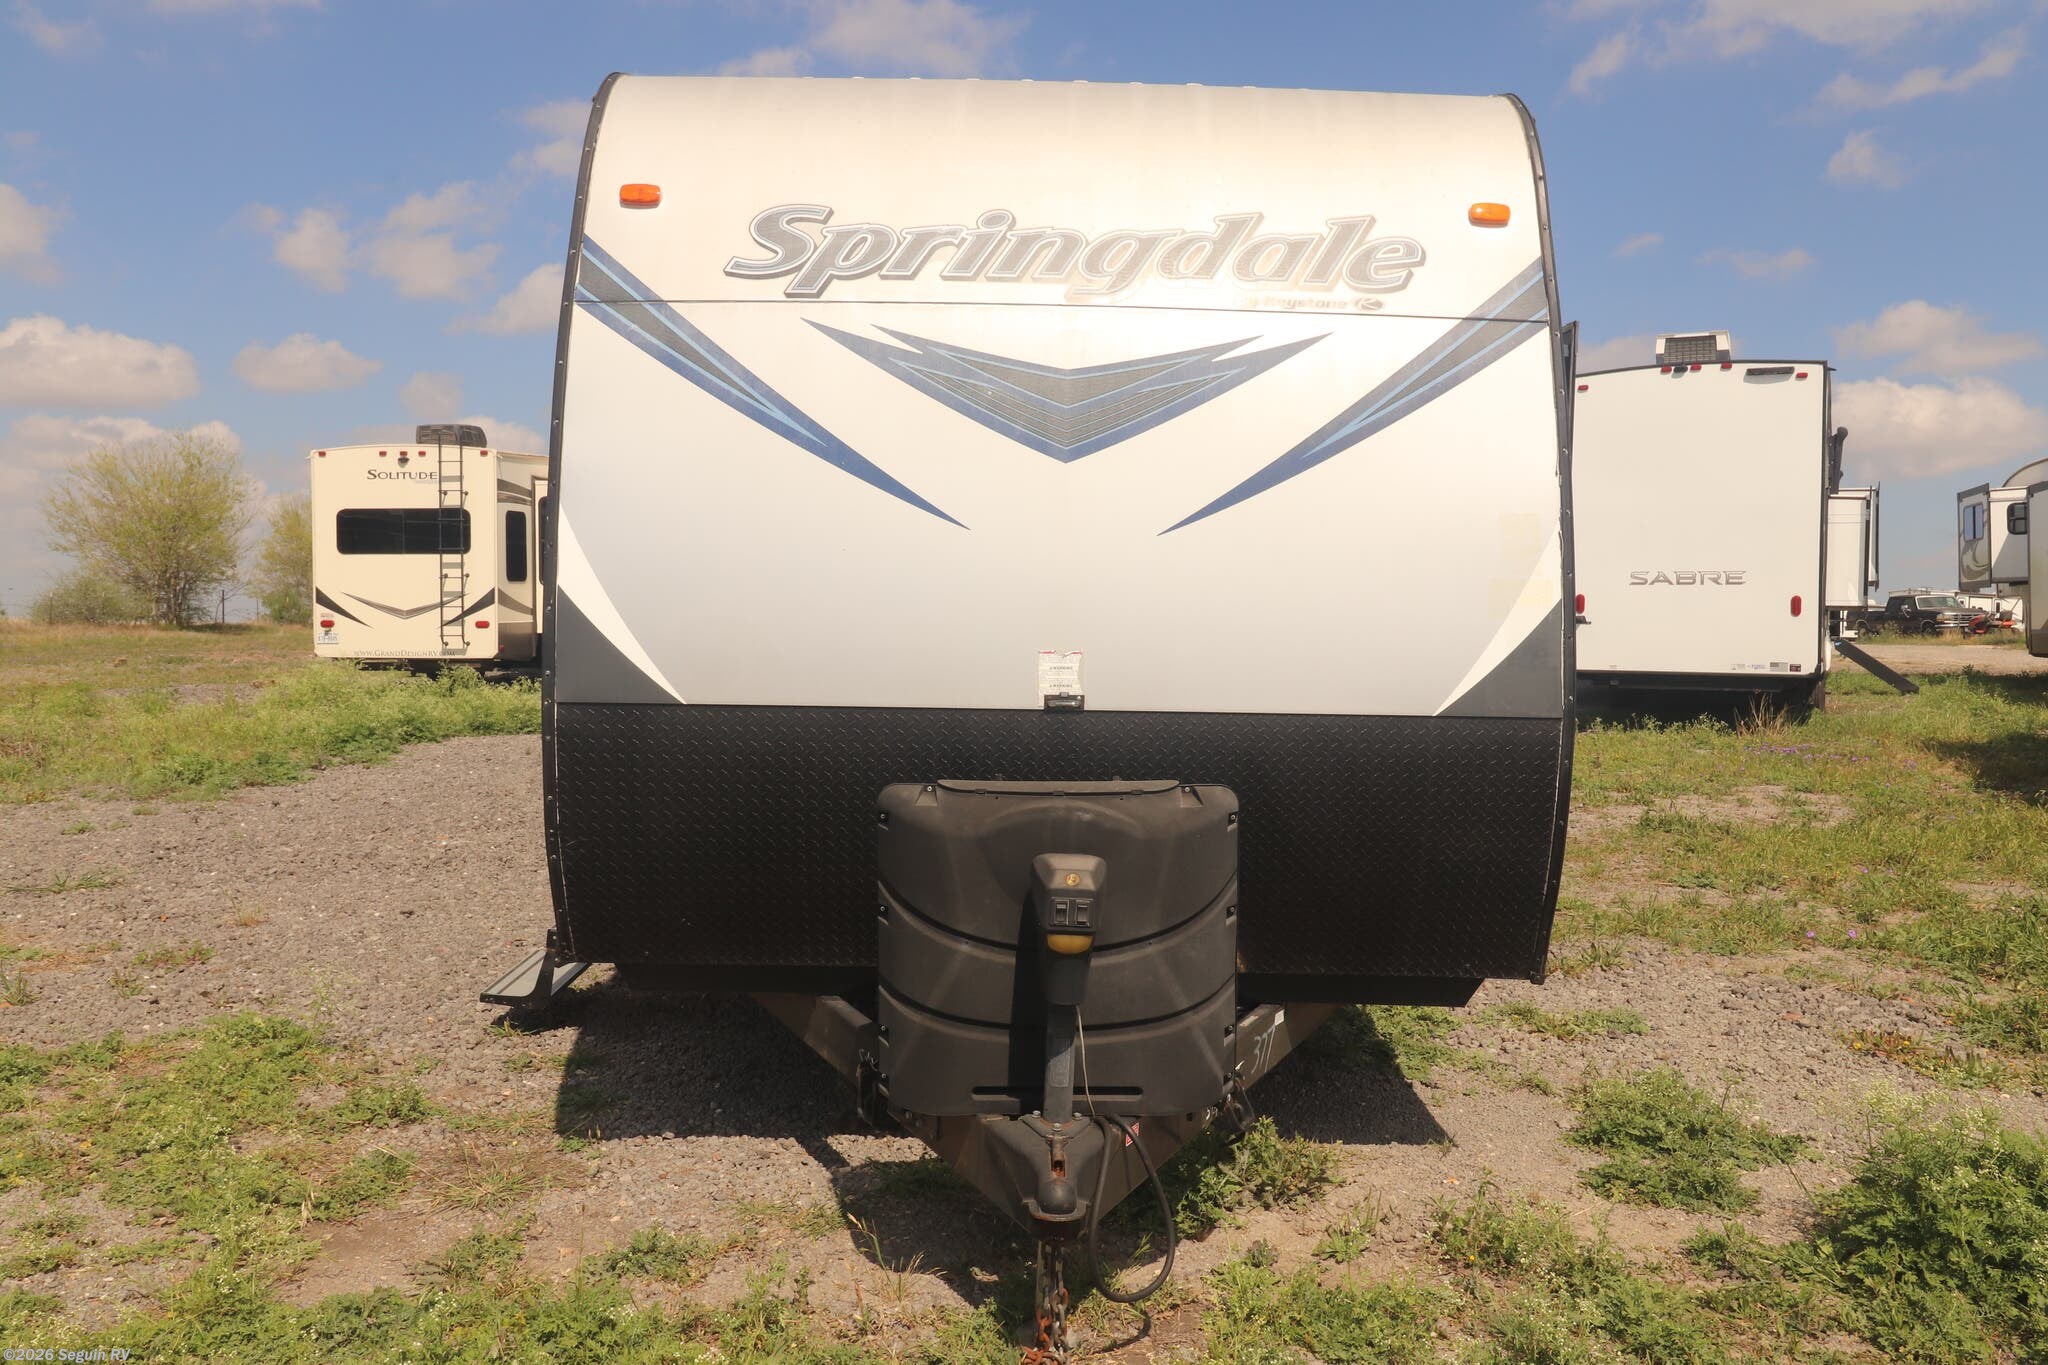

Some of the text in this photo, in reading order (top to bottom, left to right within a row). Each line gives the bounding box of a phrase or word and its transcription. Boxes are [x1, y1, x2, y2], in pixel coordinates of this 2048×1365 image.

[724, 204, 1427, 300] Springdale
[366, 469, 438, 480] SOLITUDE
[1629, 570, 1748, 586] SABRE
